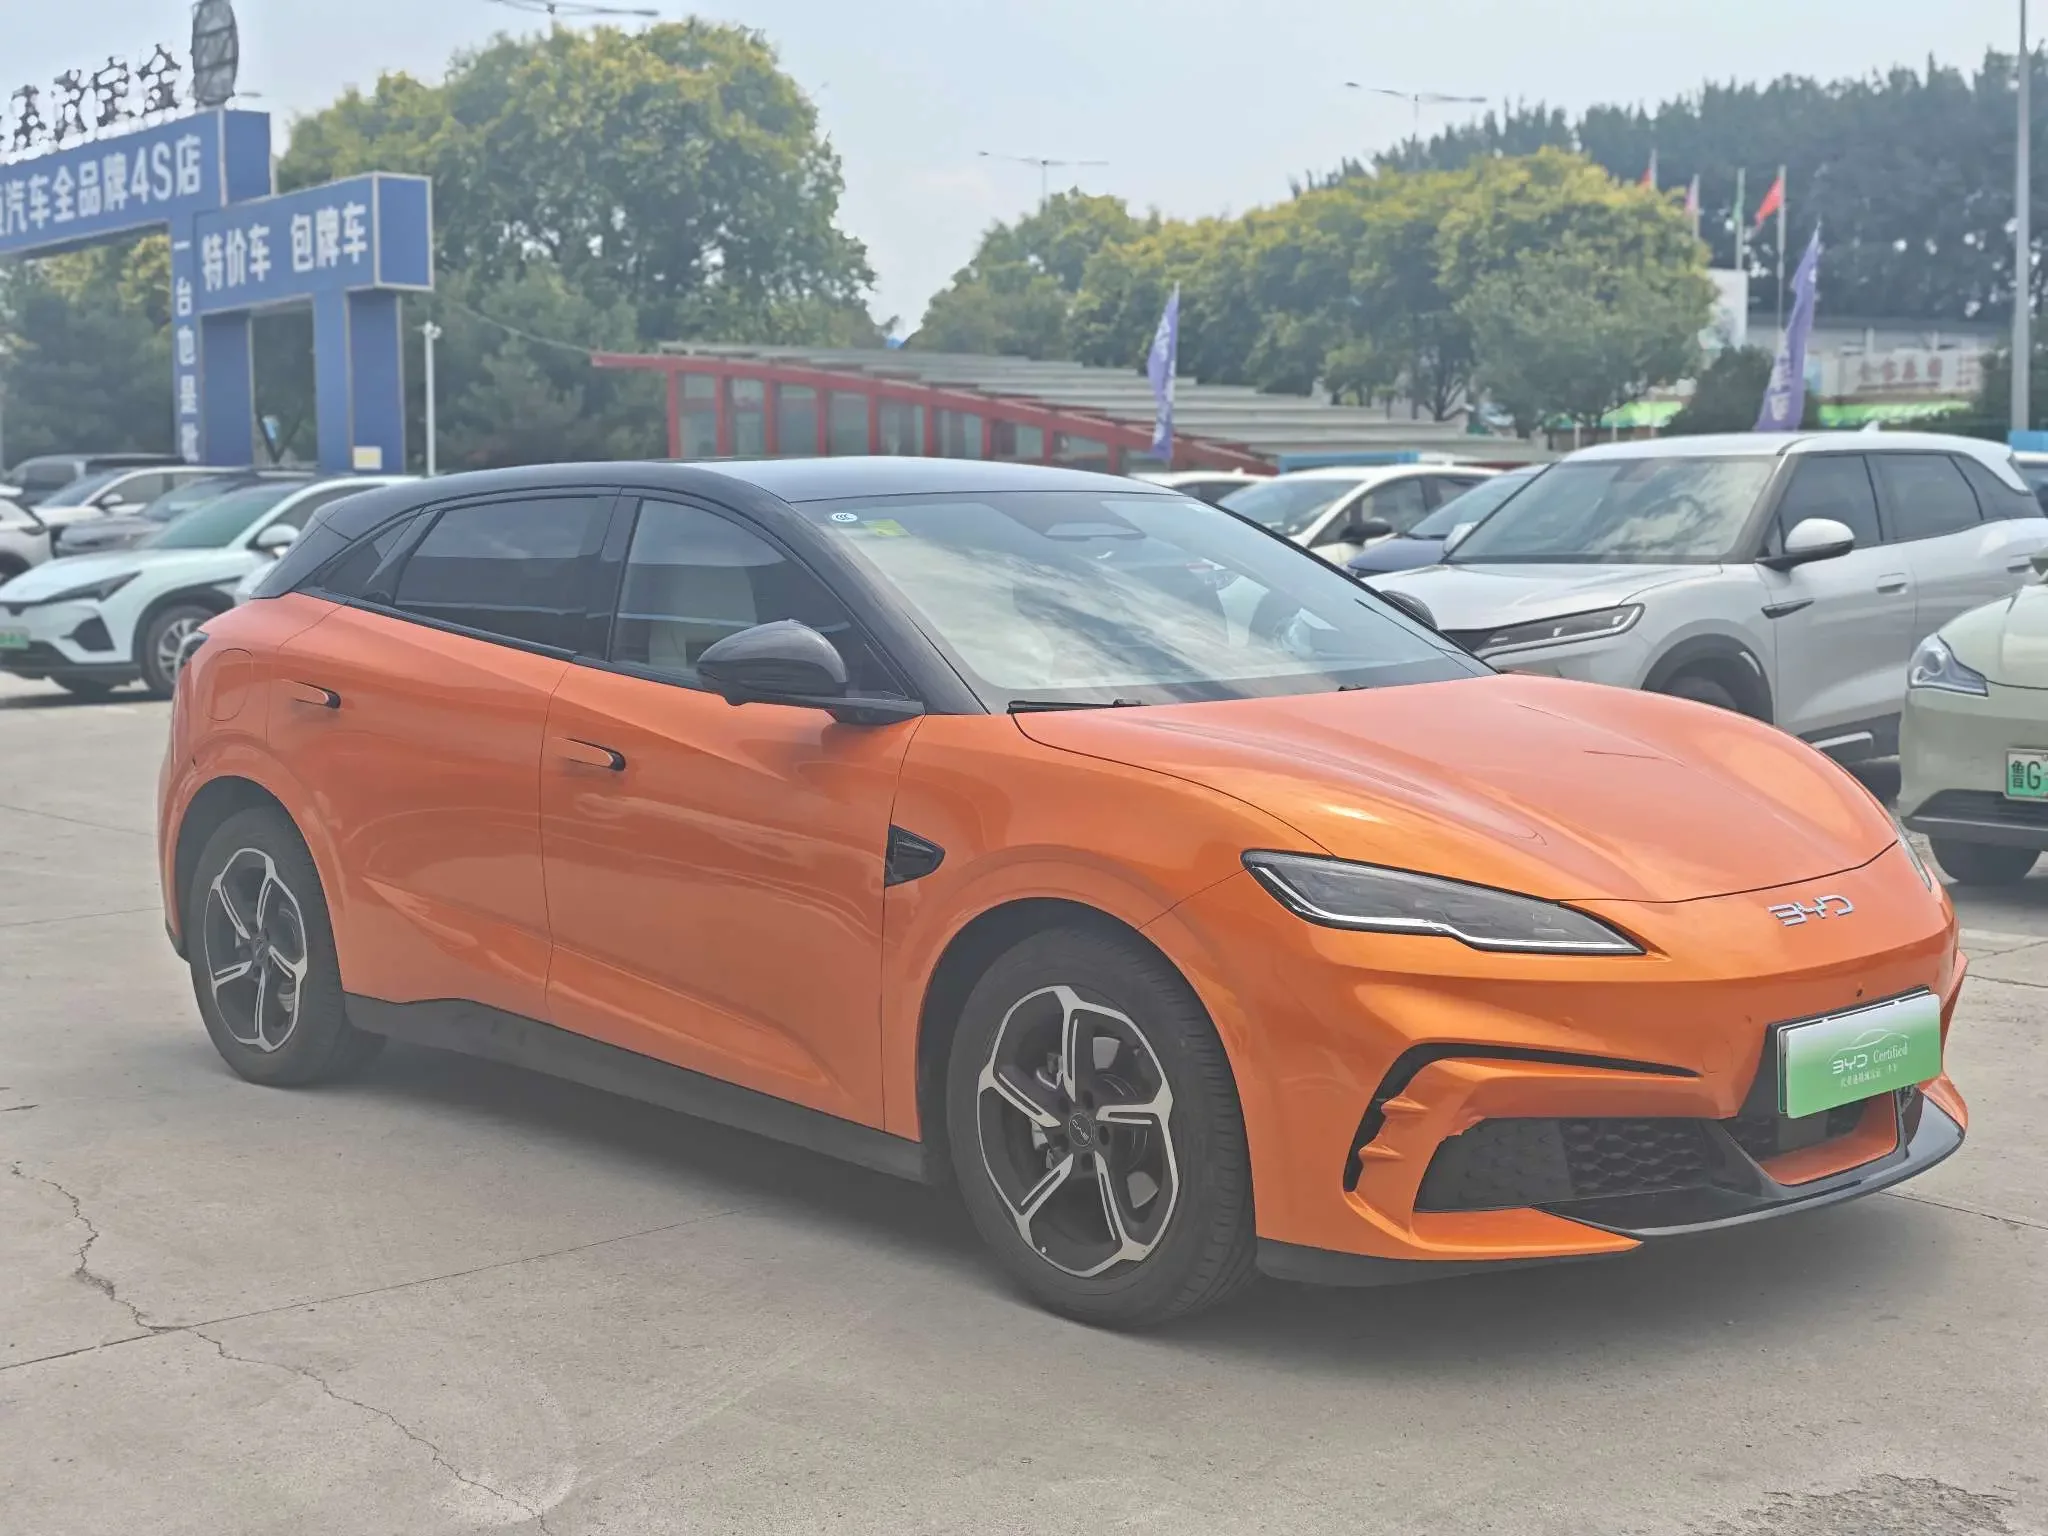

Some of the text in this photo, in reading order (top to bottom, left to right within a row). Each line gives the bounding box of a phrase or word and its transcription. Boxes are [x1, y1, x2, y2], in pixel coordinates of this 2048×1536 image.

[202, 201, 368, 291] 特价车 包牌车
[1768, 894, 1855, 927] BYD
[1832, 1053, 1868, 1075] BYD
[1873, 1040, 1909, 1063] Certified
